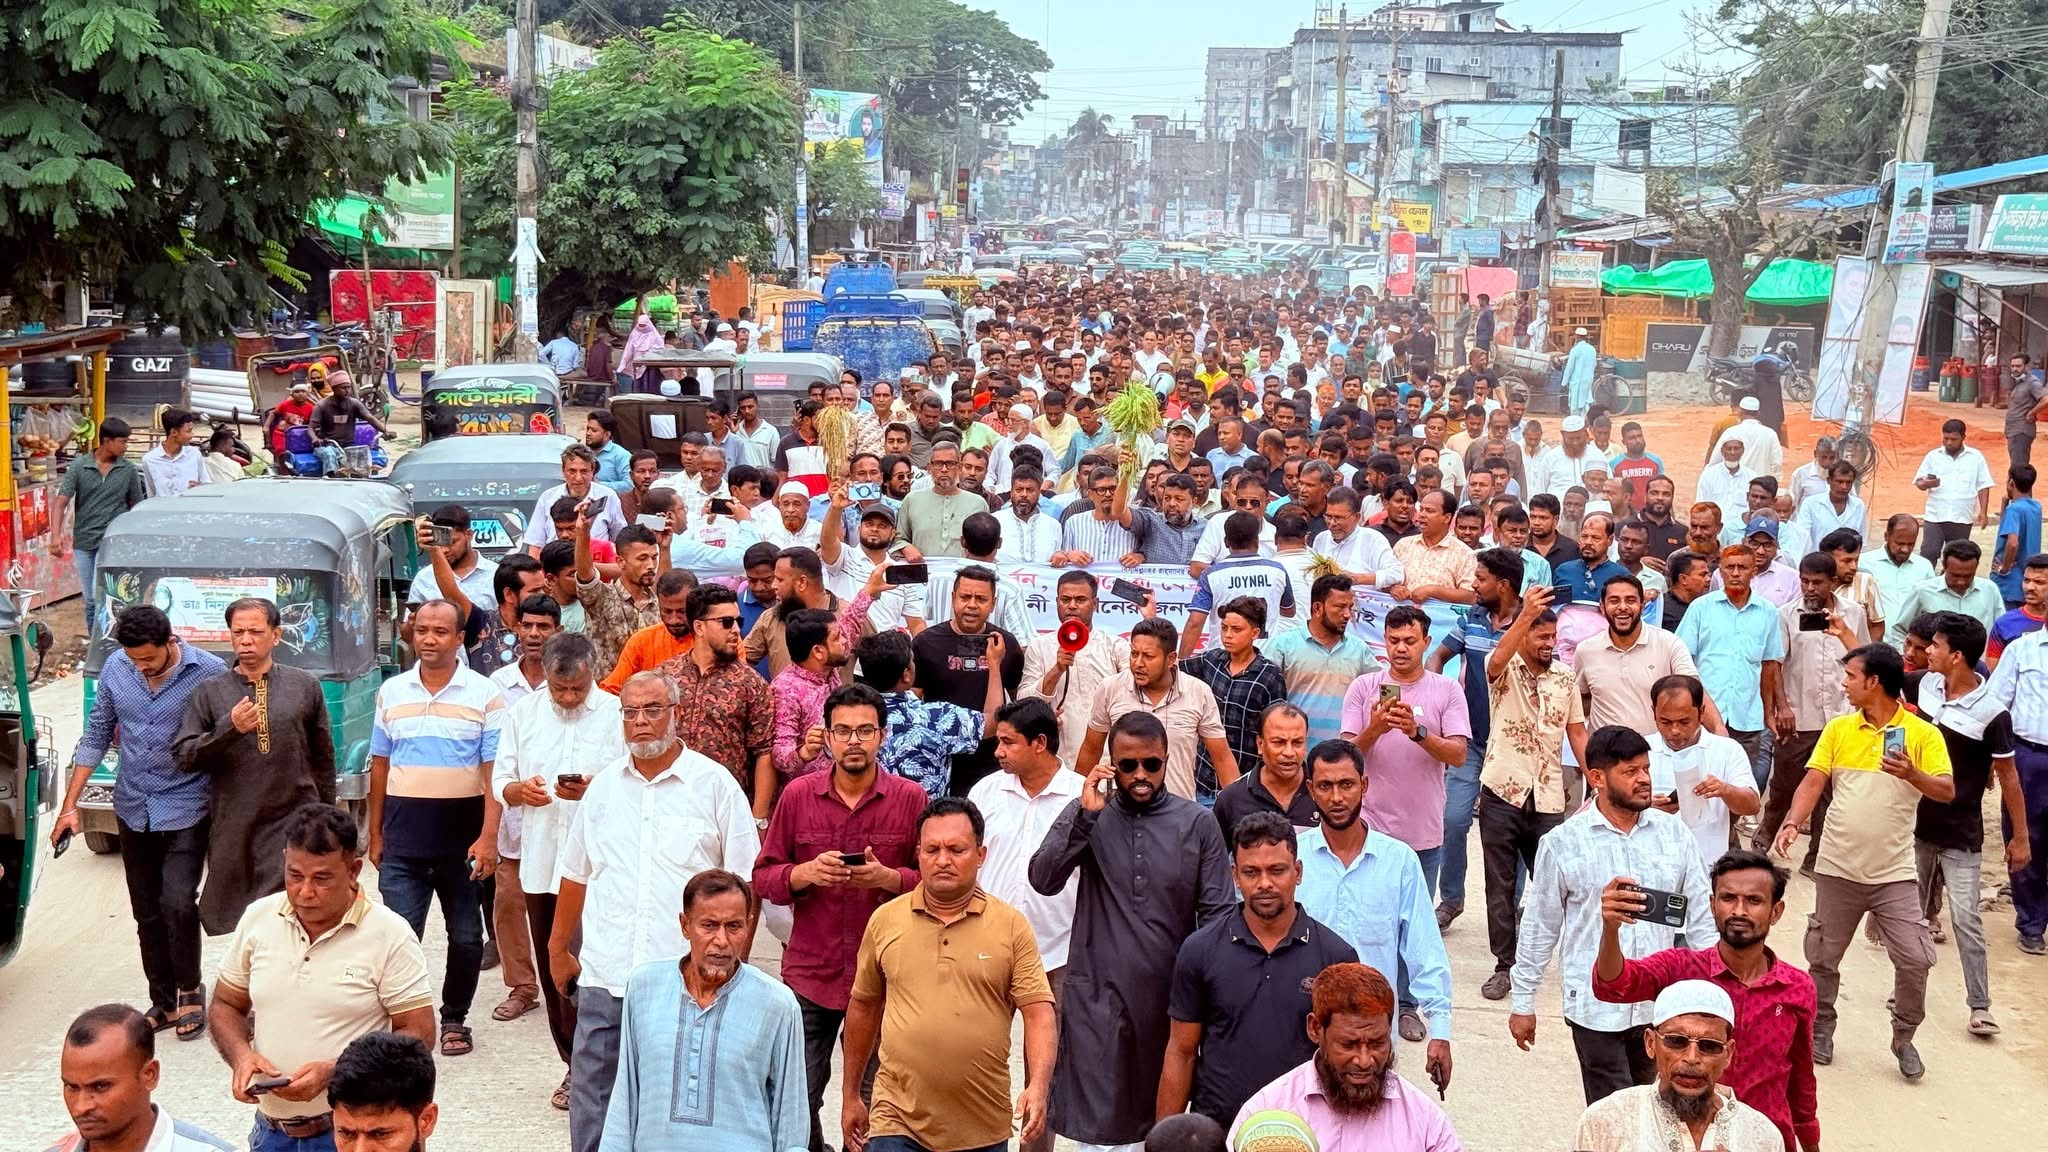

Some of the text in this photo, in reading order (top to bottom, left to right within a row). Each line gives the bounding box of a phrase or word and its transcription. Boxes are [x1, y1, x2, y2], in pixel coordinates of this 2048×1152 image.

[884, 183, 905, 191] UCC
[131, 357, 173, 372] GAZI
[434, 383, 542, 408] পাটোয়ারী
[1621, 467, 1653, 478] BURBERRY
[1228, 575, 1272, 589] JOYNAL
